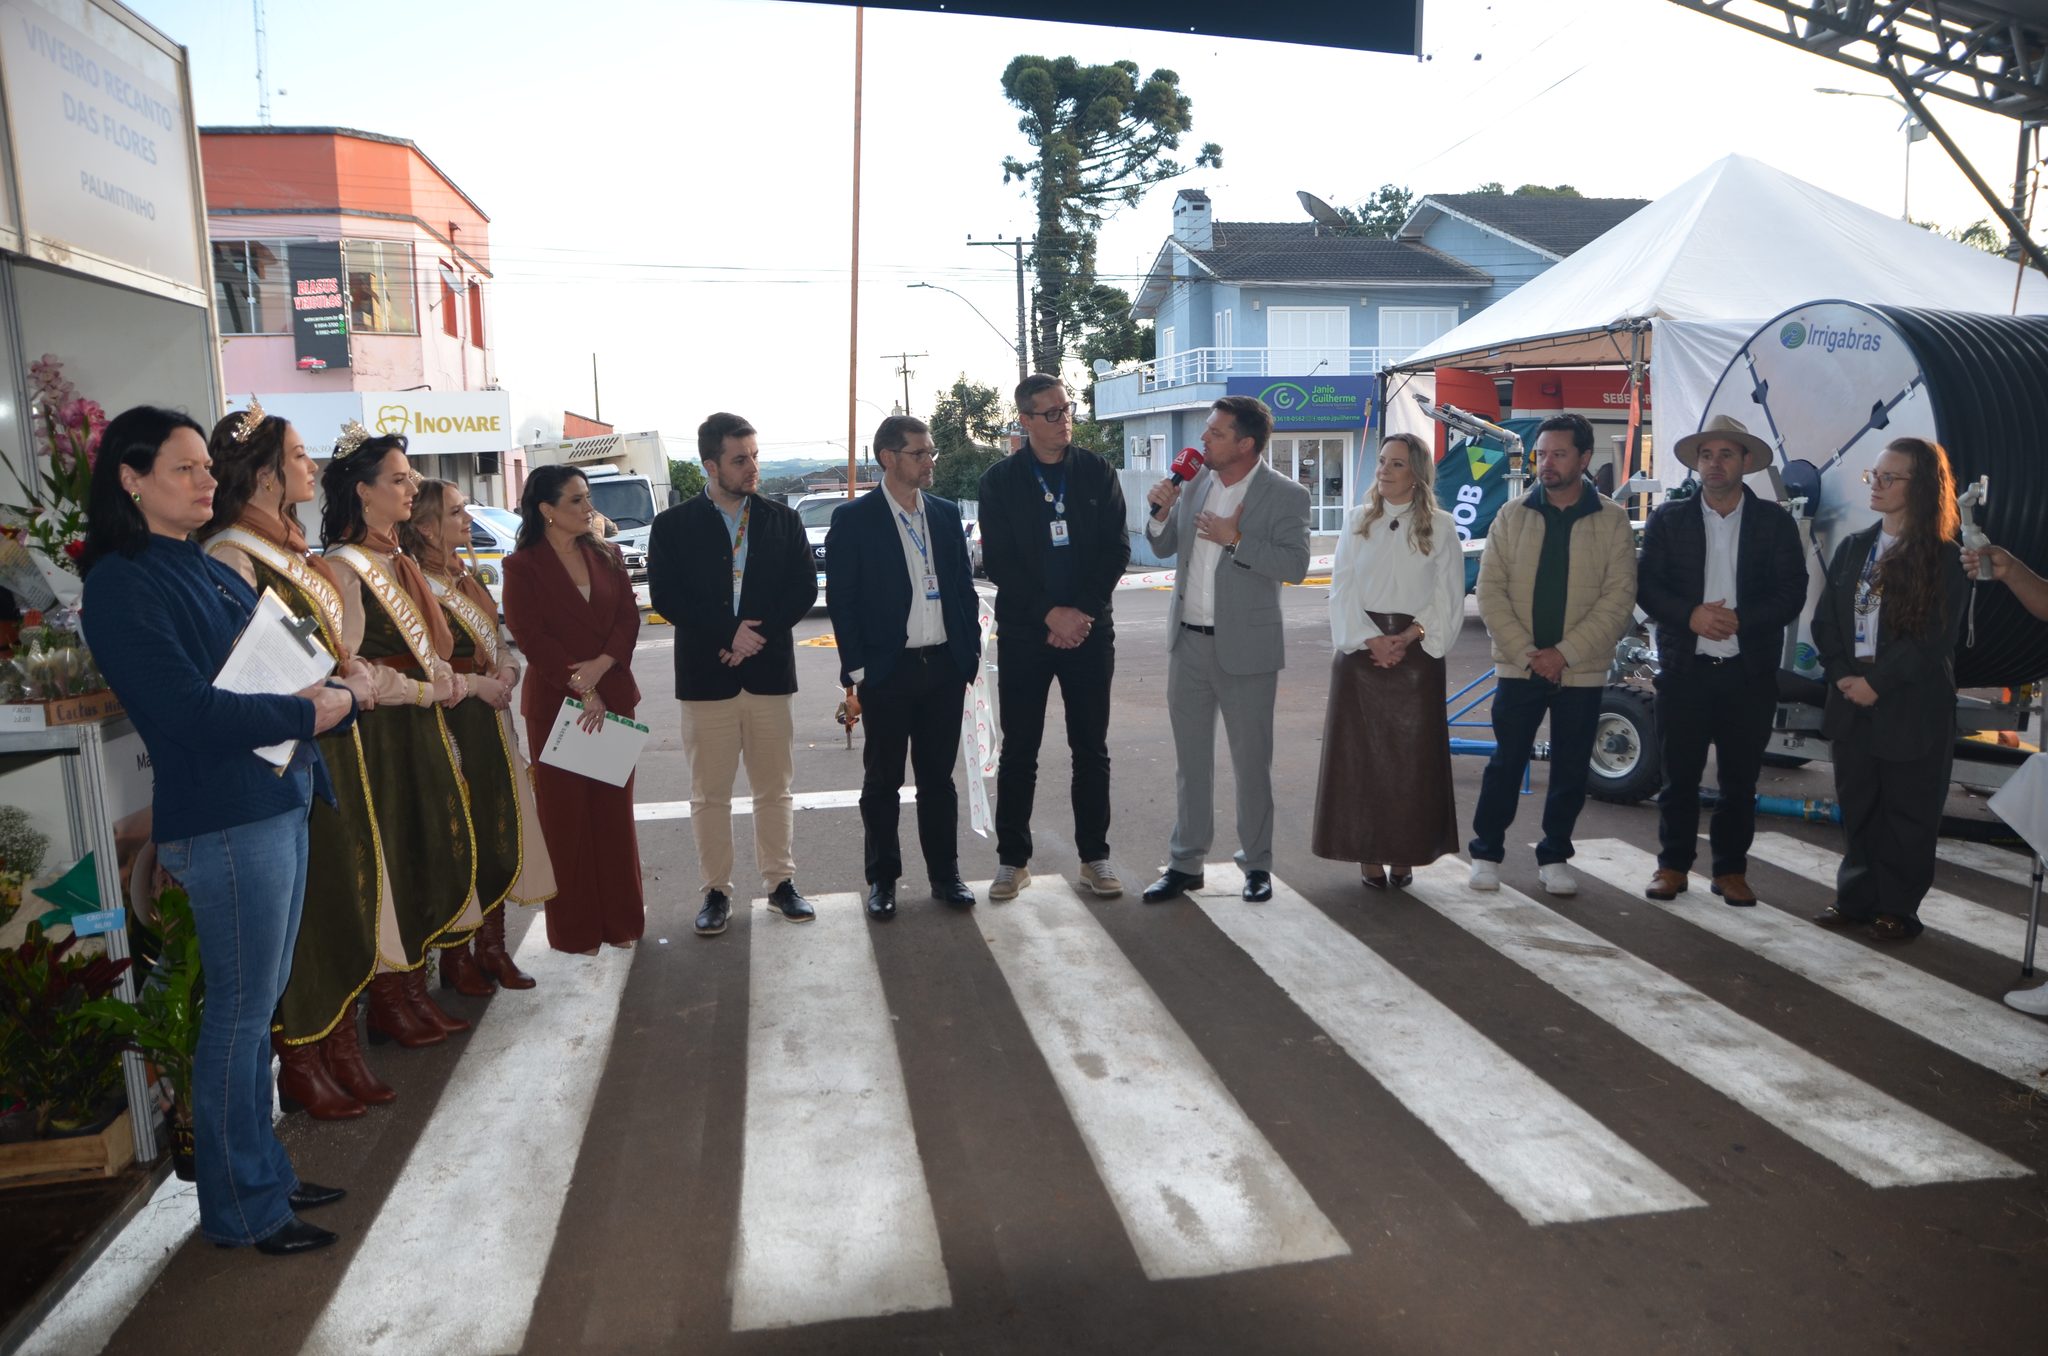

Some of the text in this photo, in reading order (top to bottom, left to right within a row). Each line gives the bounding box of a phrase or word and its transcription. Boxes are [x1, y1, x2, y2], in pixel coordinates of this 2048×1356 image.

[22, 18, 173, 132] VIVEIRO RECANTO
[61, 91, 157, 165] DAS FLORES
[80, 170, 156, 221] PALMITINHO
[1807, 323, 1882, 353] Irrigabras
[1312, 385, 1335, 394] Janio
[1312, 394, 1357, 403] Guilherme
[415, 411, 501, 434] INOVARE
[367, 565, 426, 649] RAINHA
[56, 701, 98, 721] Cactus
